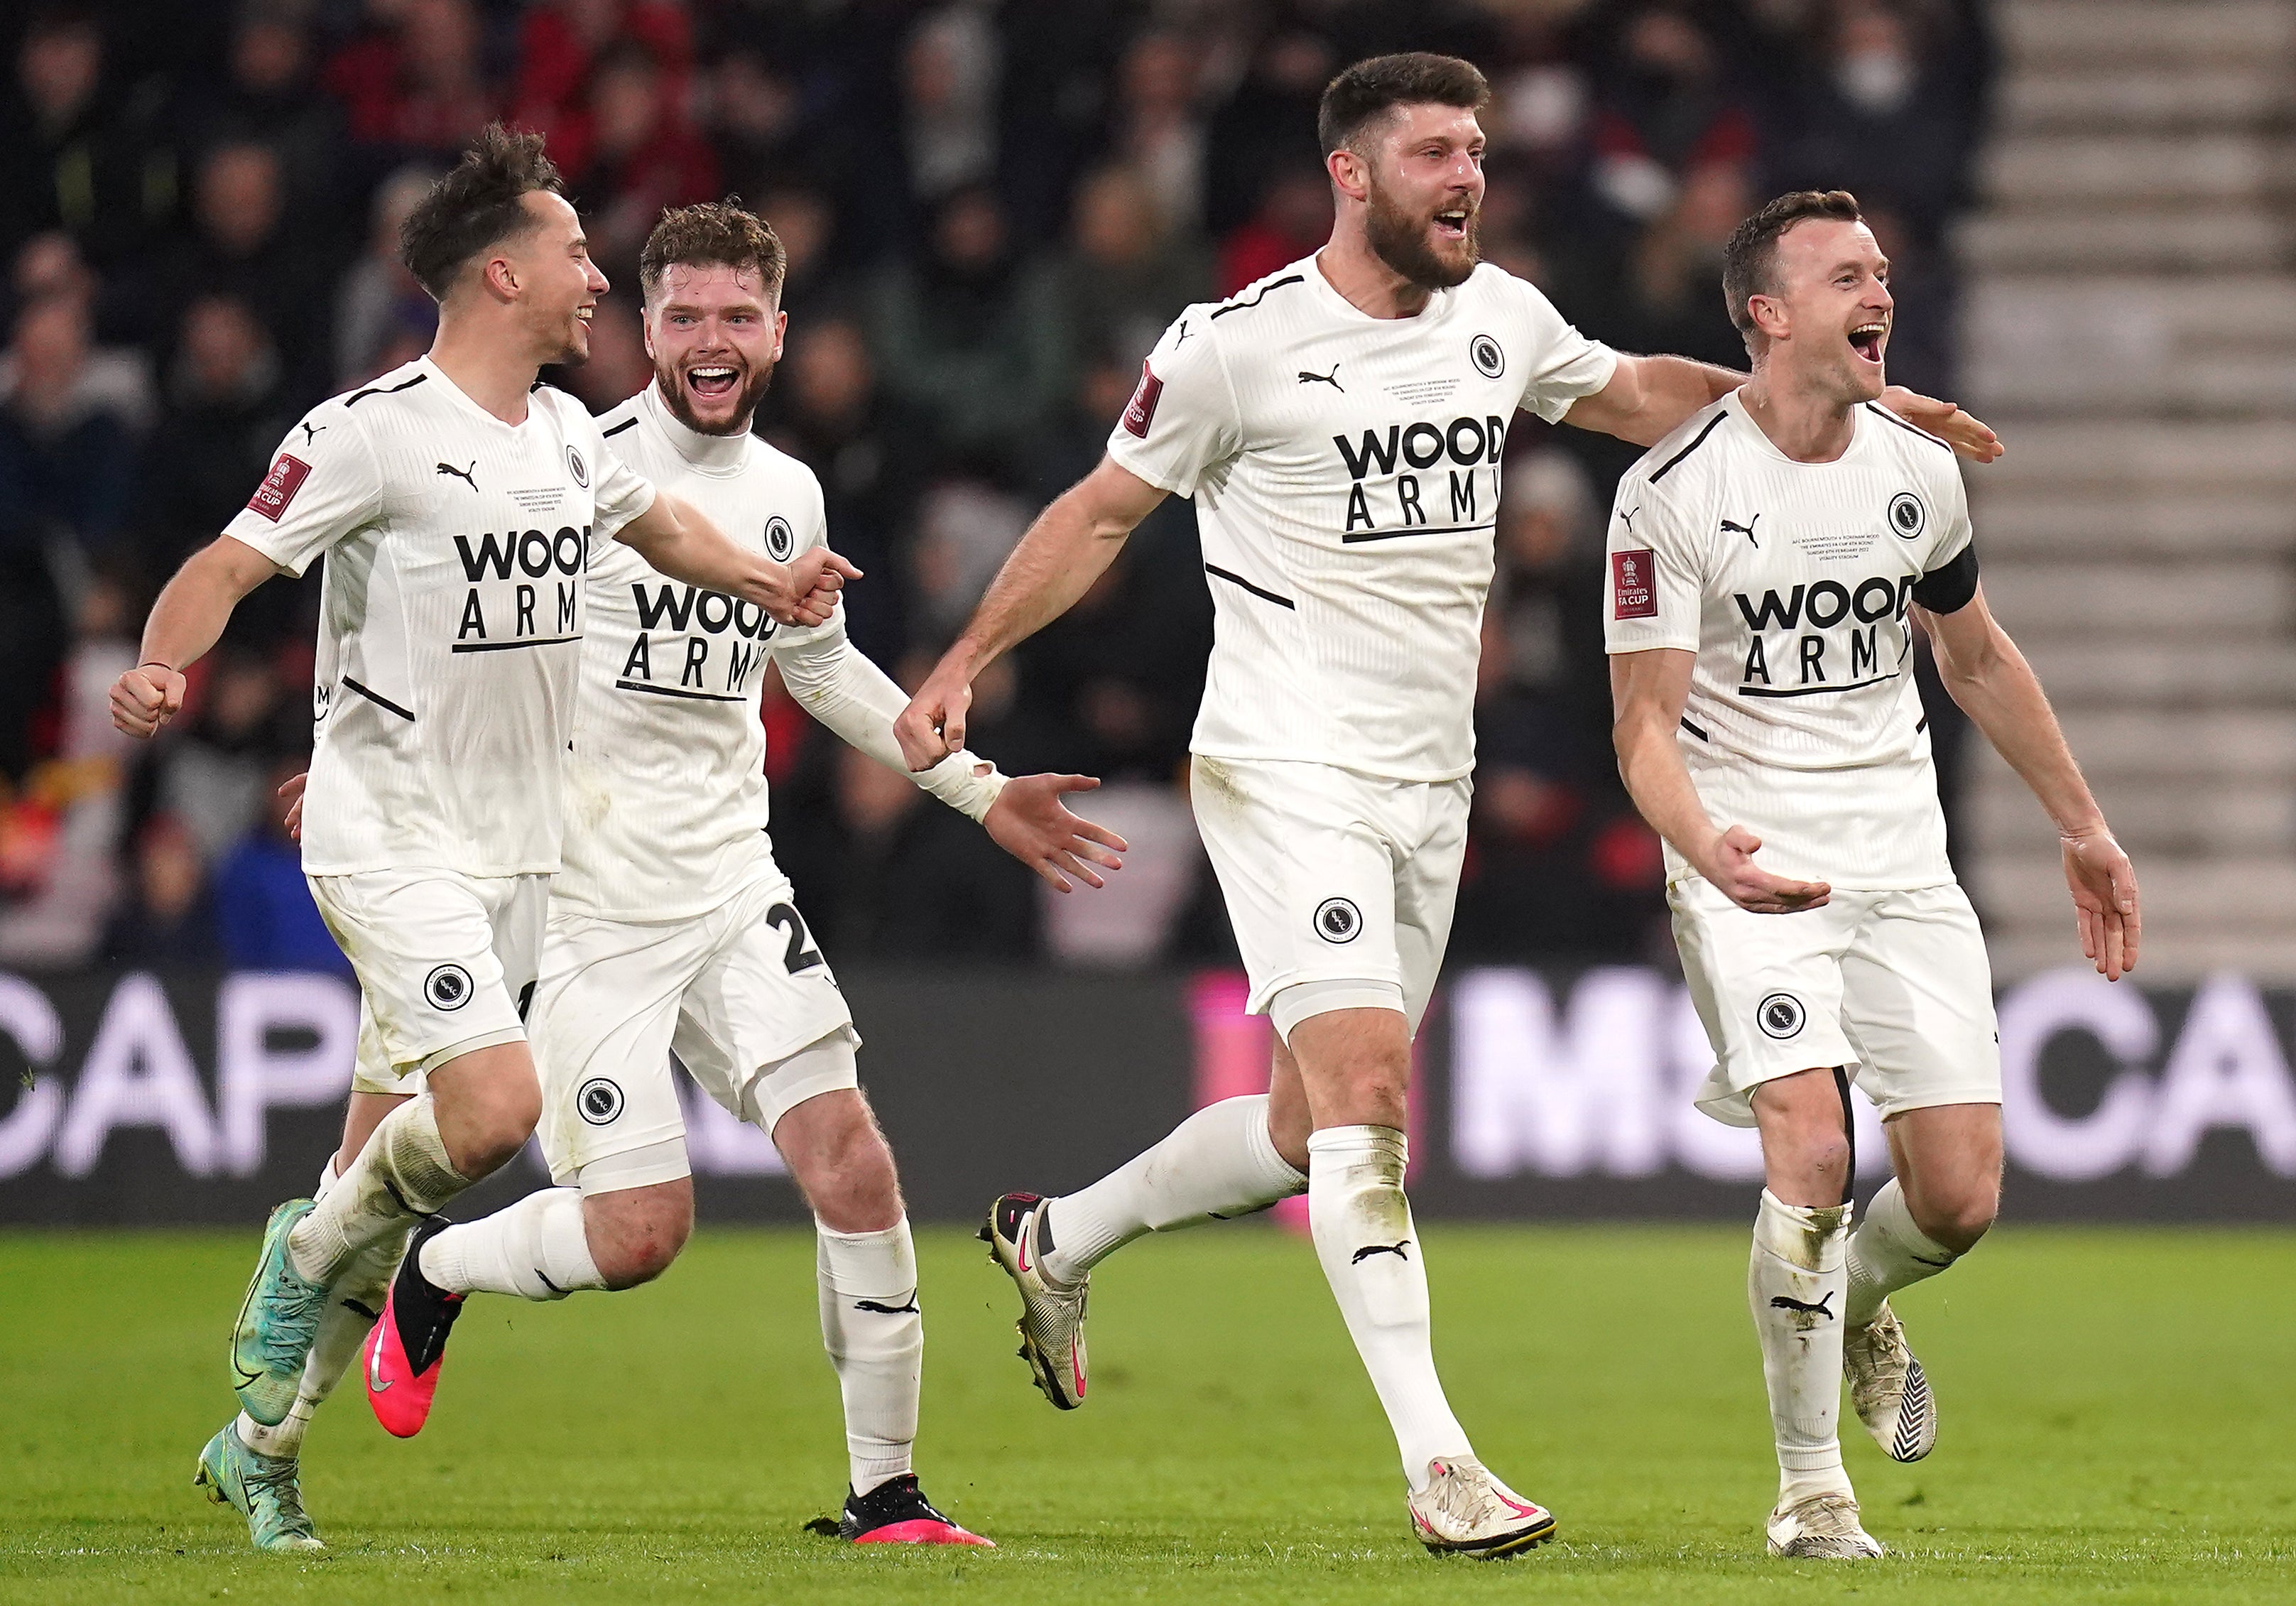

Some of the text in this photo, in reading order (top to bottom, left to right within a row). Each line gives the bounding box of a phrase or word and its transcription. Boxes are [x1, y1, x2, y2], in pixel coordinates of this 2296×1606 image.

[1333, 416, 1503, 479] WOOD
[261, 492, 281, 505] CUP
[1618, 587, 1648, 596] Emirates
[1618, 595, 1648, 606] FA CUP
[632, 584, 778, 641] WOOD
